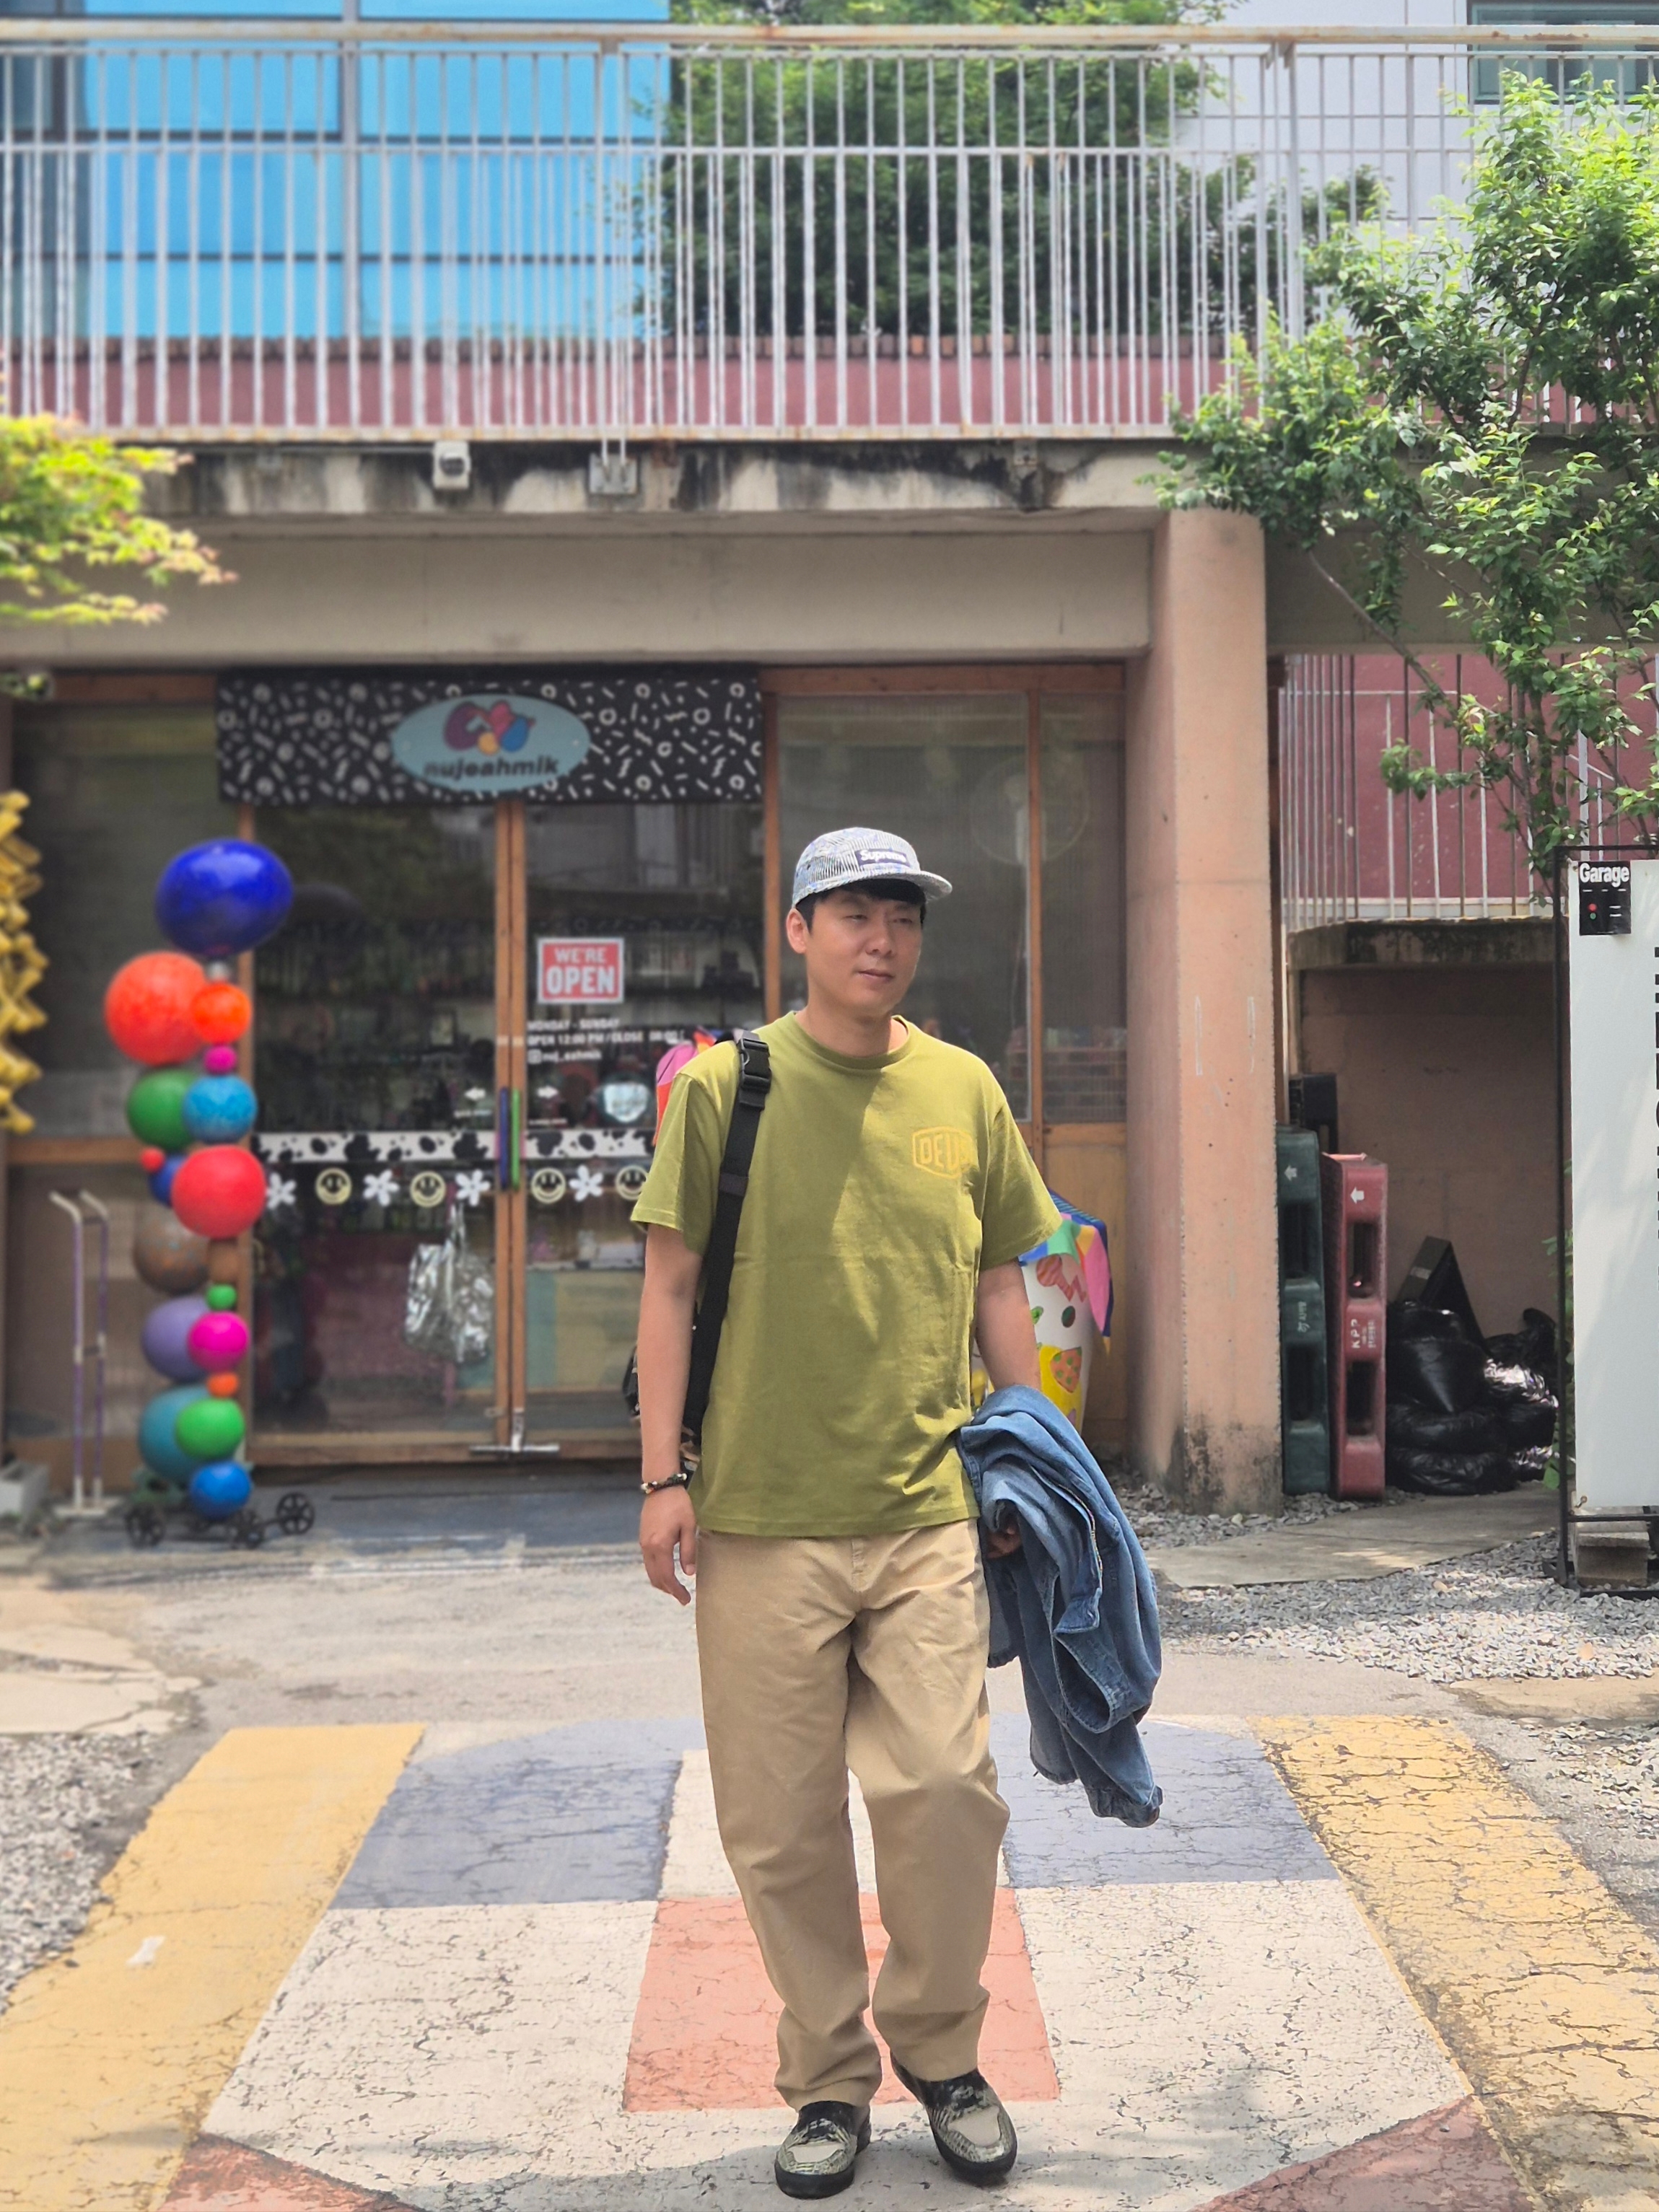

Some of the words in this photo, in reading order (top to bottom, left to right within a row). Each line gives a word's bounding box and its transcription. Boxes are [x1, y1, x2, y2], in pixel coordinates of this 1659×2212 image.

[860, 850, 906, 863] Supreme
[1580, 862, 1630, 887] Garage
[554, 948, 605, 962] WE'RE
[546, 966, 614, 994] OPEN
[528, 1021, 570, 1031] MONDAY
[579, 1019, 619, 1030] SUNDAY
[528, 1035, 555, 1046] OPEN
[587, 1032, 604, 1043] PM
